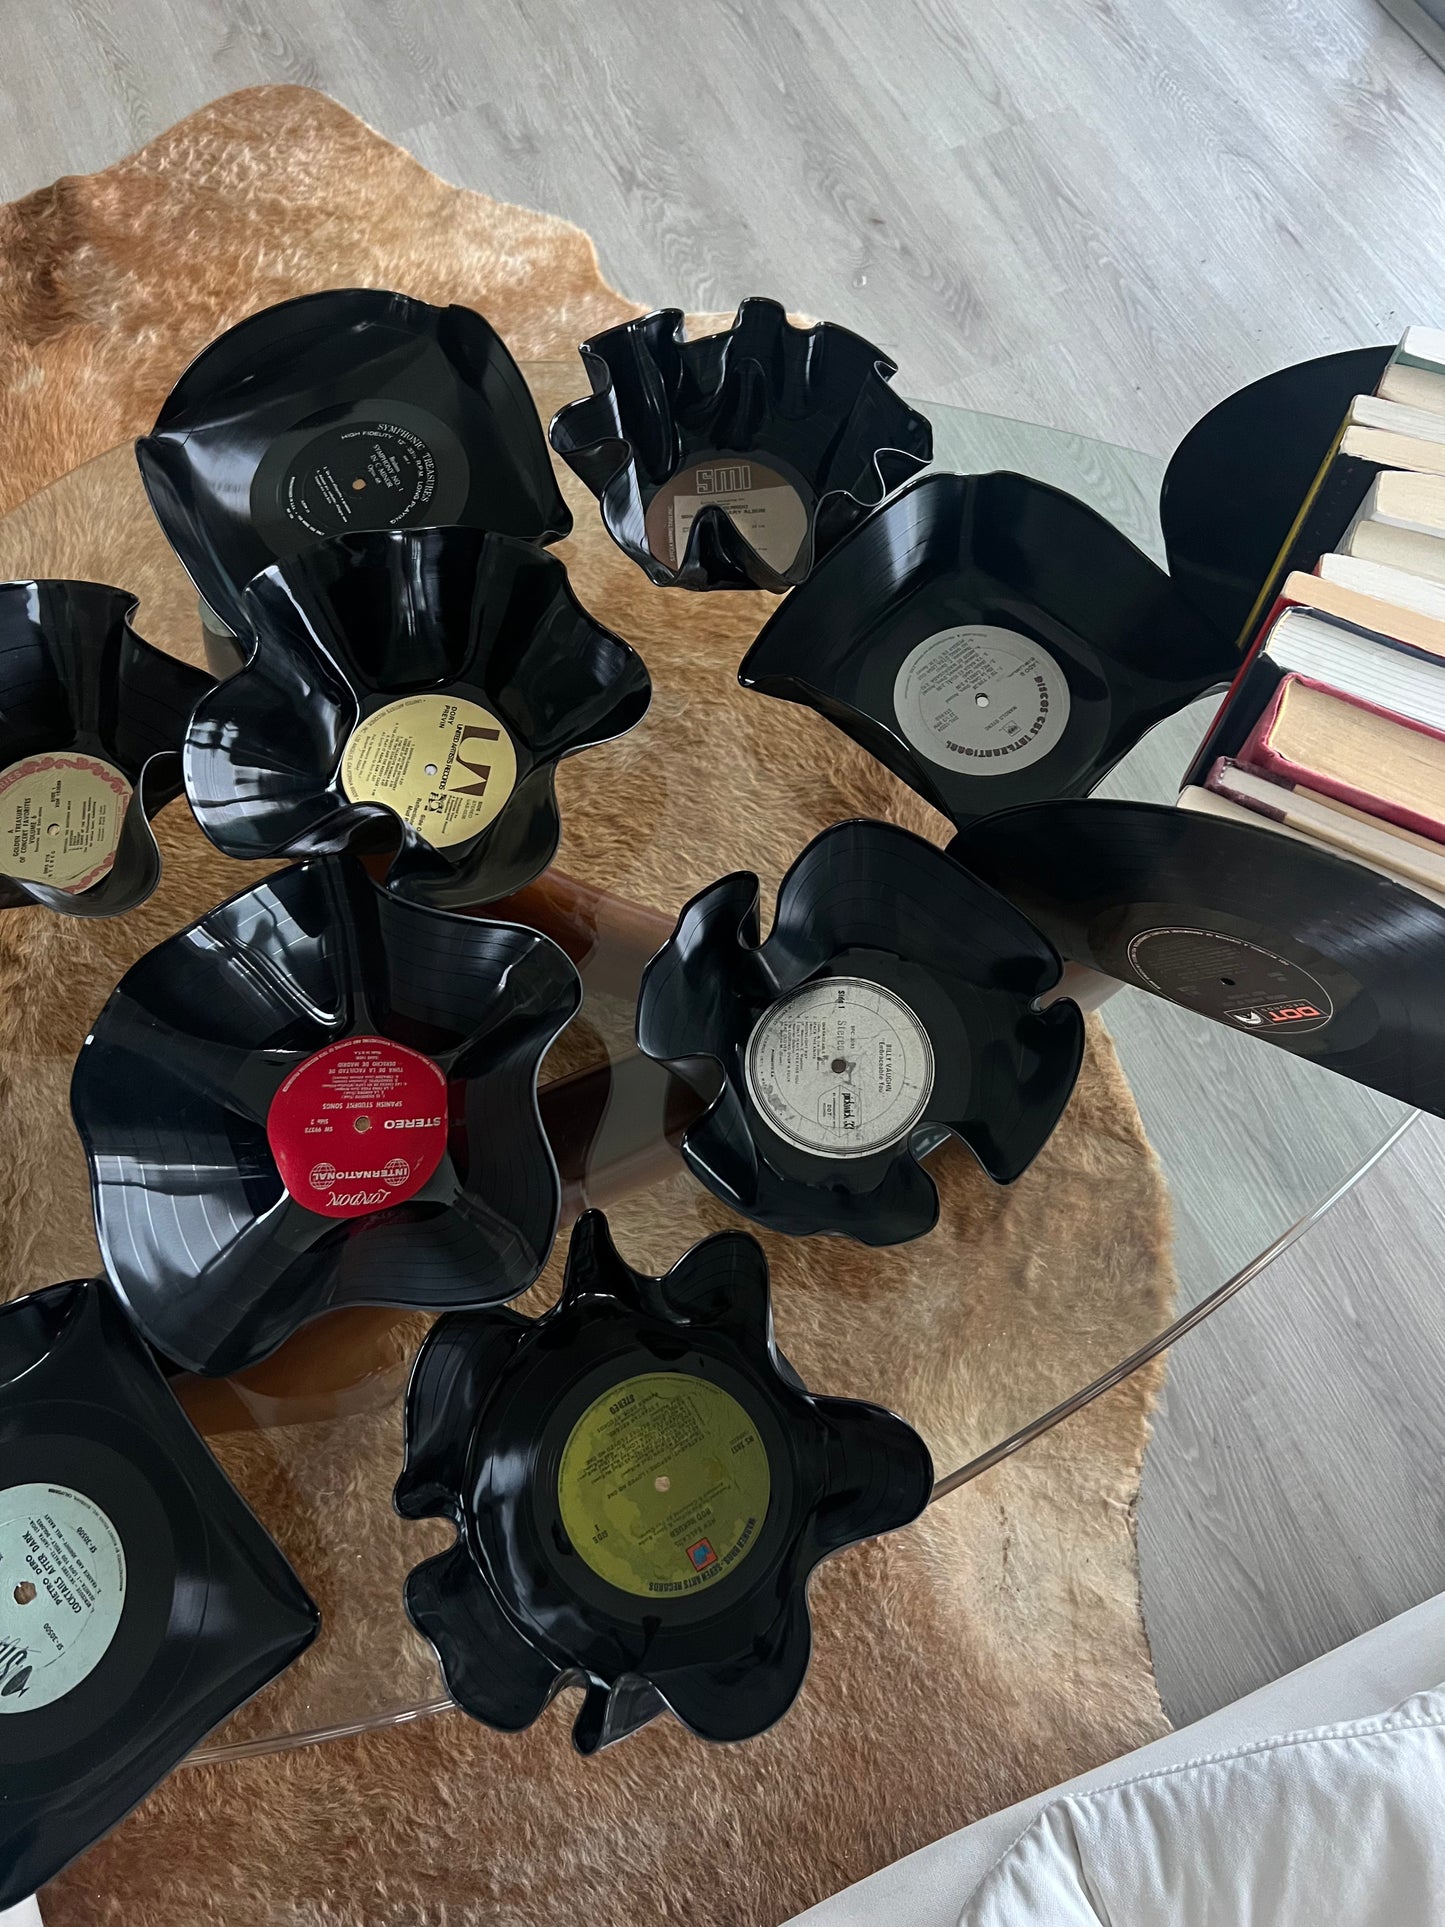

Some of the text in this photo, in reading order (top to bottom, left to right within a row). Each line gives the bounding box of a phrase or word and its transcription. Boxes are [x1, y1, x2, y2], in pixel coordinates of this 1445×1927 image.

[372, 443, 396, 476] SYMPHONY
[378, 424, 435, 502] SYMPHONIC TREASURES
[377, 467, 394, 489] MINOR
[696, 465, 751, 494] SMI
[1034, 676, 1049, 713] DISCOS
[439, 704, 450, 729] PREVIN
[447, 706, 457, 725] DORY
[1030, 717, 1045, 735] CBS
[453, 723, 463, 743] UNITED
[446, 742, 457, 765] ARTISTS
[448, 722, 500, 799] UA
[438, 764, 451, 791] RECORDS
[22, 797, 32, 827] FAVORITES
[405, 805, 413, 817] Mud
[12, 805, 23, 857] GOLDEN TREASURY
[19, 829, 29, 854] CONCERT
[28, 821, 37, 845] VOLUME
[1268, 1006, 1321, 1021] DOT
[836, 1020, 847, 1051] Stereo
[384, 1116, 441, 1129] STEREO
[843, 1121, 855, 1130] 33
[312, 1168, 407, 1181] INTERNATIONAL
[325, 1188, 391, 1206] LONDON
[608, 1393, 636, 1416] STEREO
[21, 1530, 84, 1614] COCKTAILS AFTER DARK
[23, 1553, 64, 1606] PIETRO DERO
[682, 1575, 703, 1589] ARTS
[649, 1582, 683, 1592] RECORDS
